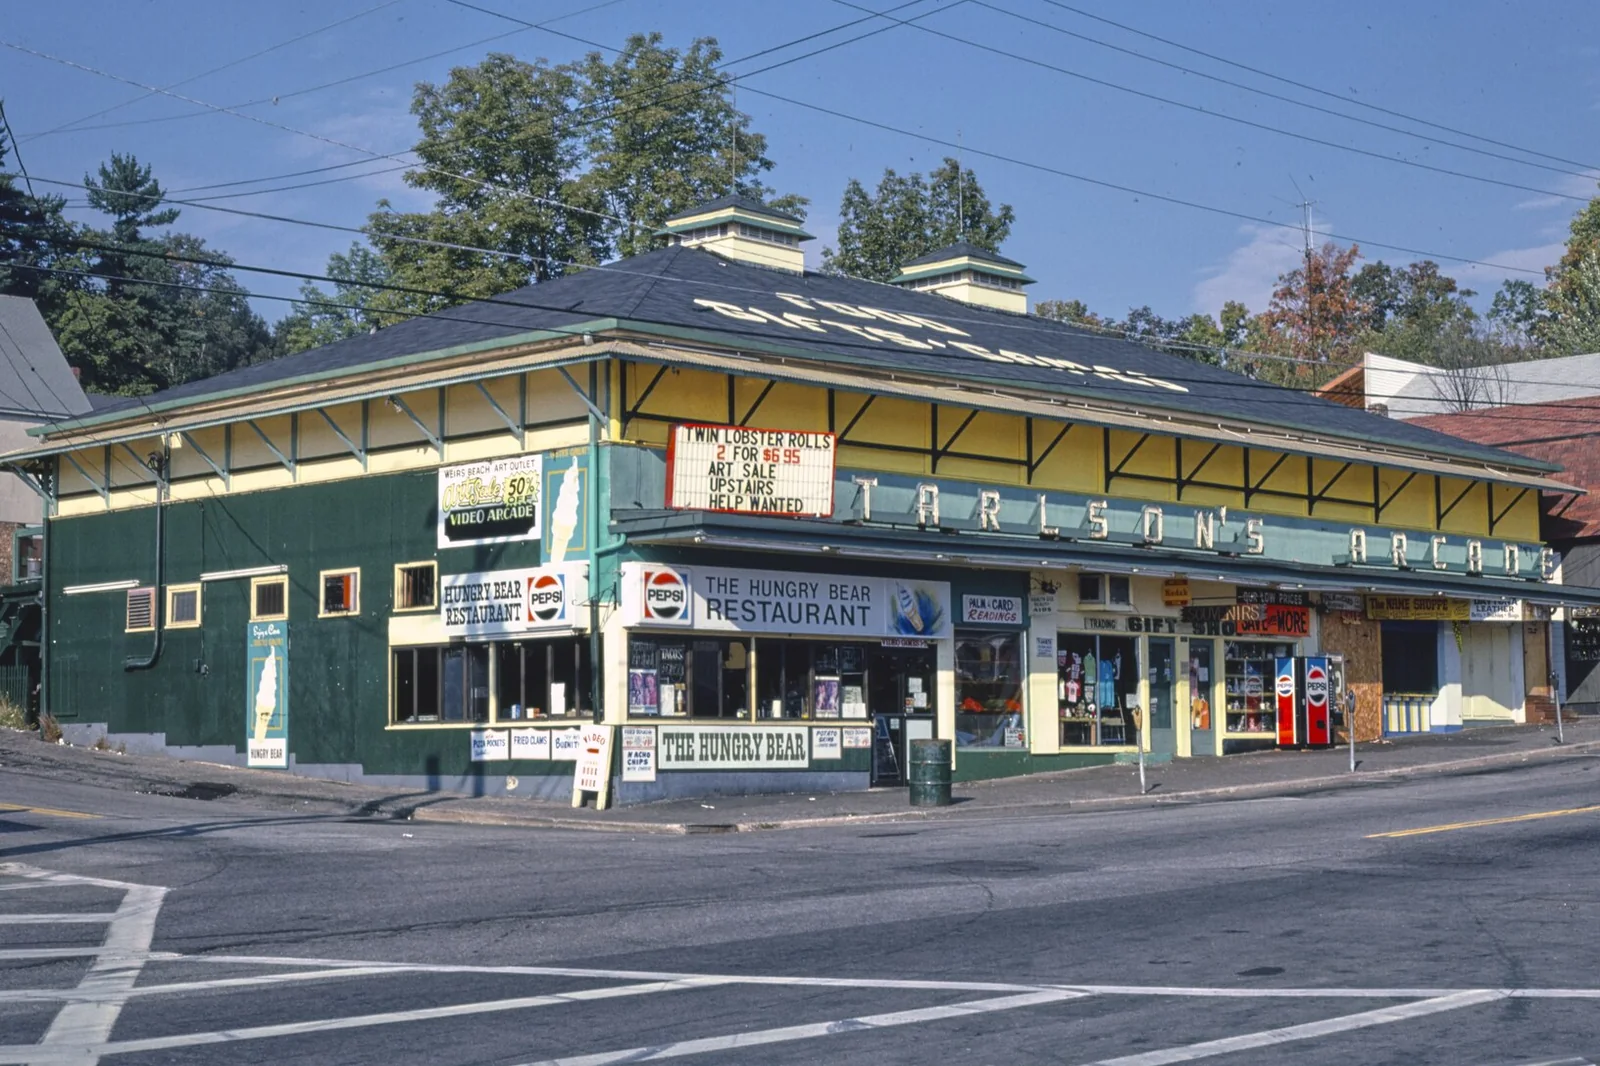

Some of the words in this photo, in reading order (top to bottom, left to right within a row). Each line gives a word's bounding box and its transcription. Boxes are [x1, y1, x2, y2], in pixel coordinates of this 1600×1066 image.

[686, 427, 719, 442] TWIN
[725, 430, 784, 447] LOBSTER
[788, 433, 831, 449] ROLLS
[717, 445, 725, 460] 2
[734, 446, 758, 462] FOR
[444, 469, 465, 479] WEIRS
[468, 466, 490, 476] BEACH
[494, 463, 508, 472] ART
[510, 459, 535, 470] OUTLET
[709, 462, 733, 477] ART
[743, 464, 776, 479] SALE
[508, 477, 535, 496] 50%
[710, 479, 774, 496] UPSTAIRS
[508, 494, 533, 504] OFF
[709, 494, 743, 510] HELP
[750, 497, 803, 513] WANTED
[450, 509, 485, 526] VIDEO
[487, 504, 533, 522] ARCADE
[1349, 527, 1554, 581] ARCADE
[444, 582, 491, 604] HUNGRY
[494, 580, 522, 599] BEAR
[647, 589, 684, 603] PEPSI
[705, 576, 739, 595] THE
[750, 579, 819, 599] HUNGRY
[829, 583, 871, 601] BEAR
[531, 590, 563, 605] PEPSI
[968, 598, 986, 609] PALM
[992, 599, 1014, 611] CARD
[445, 603, 522, 626] RESTAURANT
[707, 598, 871, 626] RESTAURANT
[968, 609, 1017, 621] READINGS
[1187, 605, 1260, 621] SOUVENIRS
[1476, 605, 1514, 613] LEATHER
[1127, 616, 1177, 633] GIFT
[1192, 621, 1236, 636] SHO
[1277, 610, 1307, 633] MORE
[1307, 682, 1326, 691] PEPSI
[487, 738, 506, 747] POCKETS
[513, 735, 529, 745] FRIED
[530, 735, 548, 745] CLAMS
[583, 732, 606, 747] VIDEO
[663, 732, 695, 761] THE
[699, 732, 763, 761] HUNGRY
[766, 732, 806, 761] BEAR
[251, 748, 268, 758] HUNGRY
[270, 748, 282, 758] BEAR
